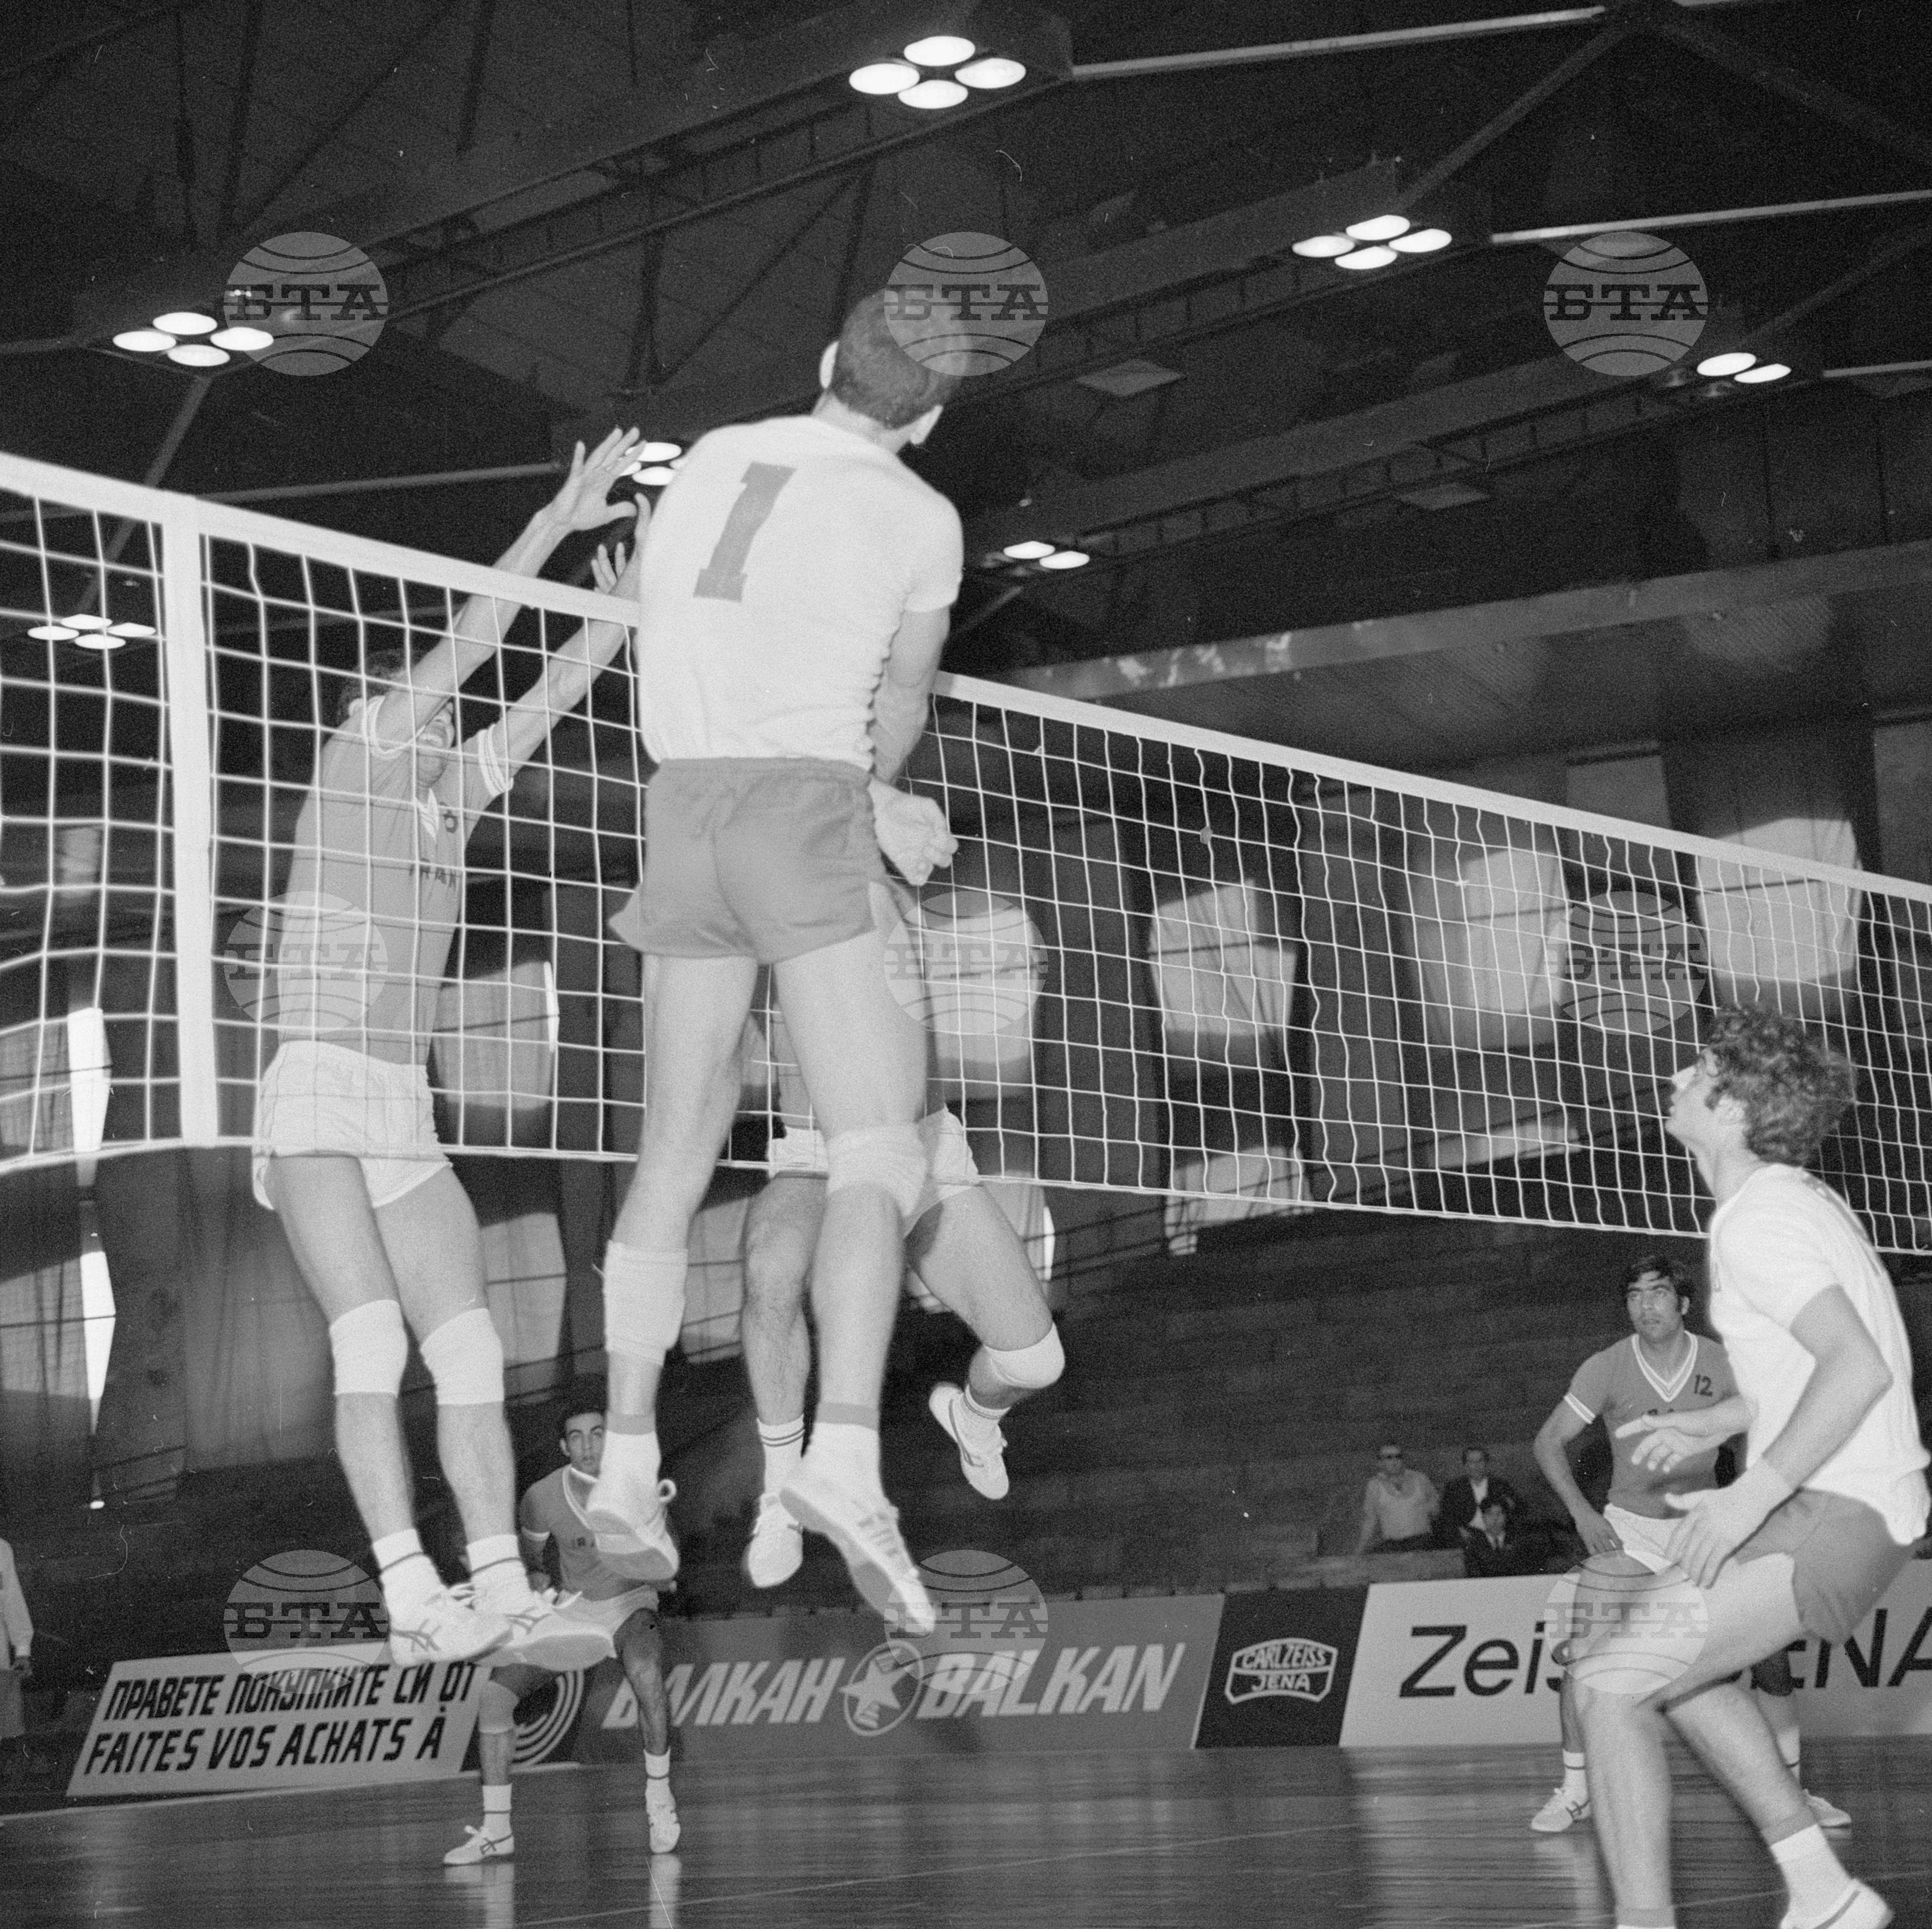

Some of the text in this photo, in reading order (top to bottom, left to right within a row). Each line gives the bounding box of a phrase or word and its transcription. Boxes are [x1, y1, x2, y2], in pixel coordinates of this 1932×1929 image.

[693, 460, 796, 603] 1
[1694, 1375, 1713, 1397] 12
[103, 1674, 226, 1720] ПРАВЕТЕ
[917, 1642, 1186, 1718] BALKAN
[1251, 1673, 1310, 1691] JENA
[84, 1728, 205, 1775] FAITES
[207, 1724, 277, 1769] VOS
[276, 1718, 412, 1766] ACHATS
